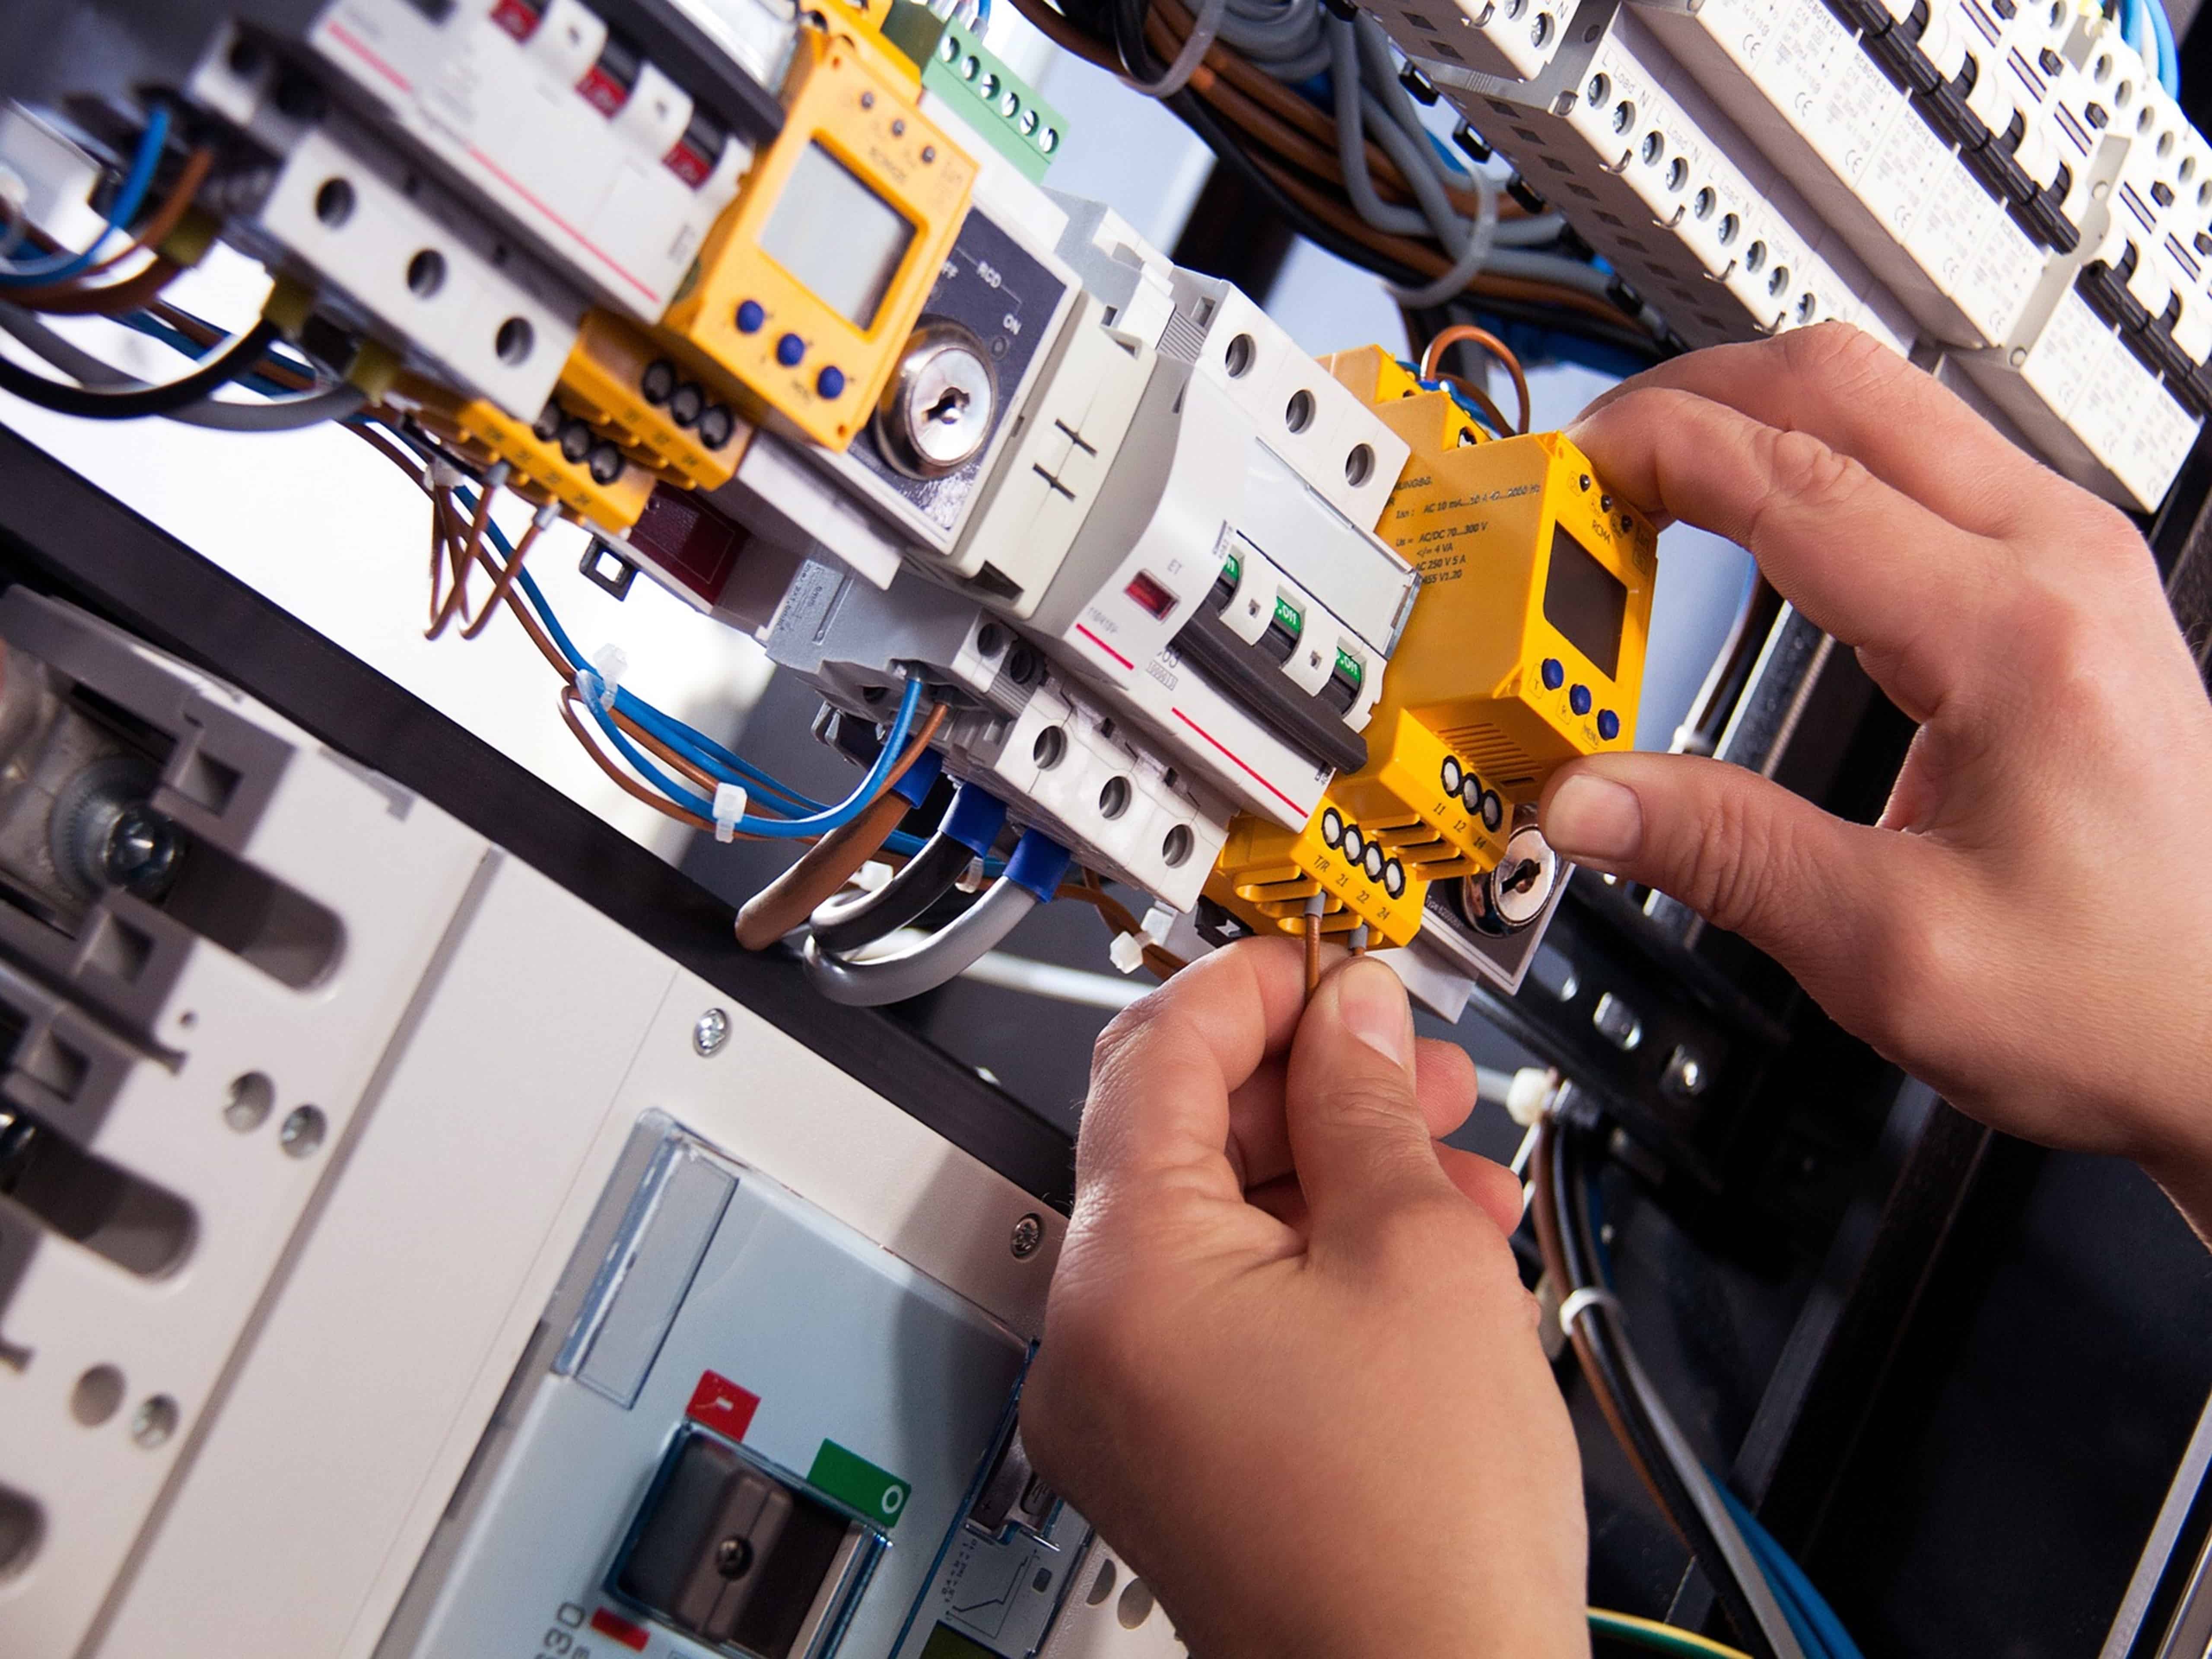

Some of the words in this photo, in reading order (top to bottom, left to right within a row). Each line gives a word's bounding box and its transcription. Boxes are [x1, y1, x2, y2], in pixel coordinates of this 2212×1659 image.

[941, 260, 959, 280] FF
[977, 261, 1002, 289] RCD
[1003, 313, 1022, 335] ON
[1442, 541, 1453, 553] VA
[1427, 557, 1443, 569] 250
[1444, 556, 1451, 566] V
[1452, 554, 1459, 566] 5
[1460, 553, 1467, 564] A
[1433, 802, 1446, 816] 11
[1453, 819, 1467, 833] 12
[1473, 836, 1487, 850] 14
[1313, 855, 1330, 873] T/R
[1335, 873, 1349, 888] 21
[1356, 890, 1370, 905] 22
[1376, 906, 1390, 921] 24
